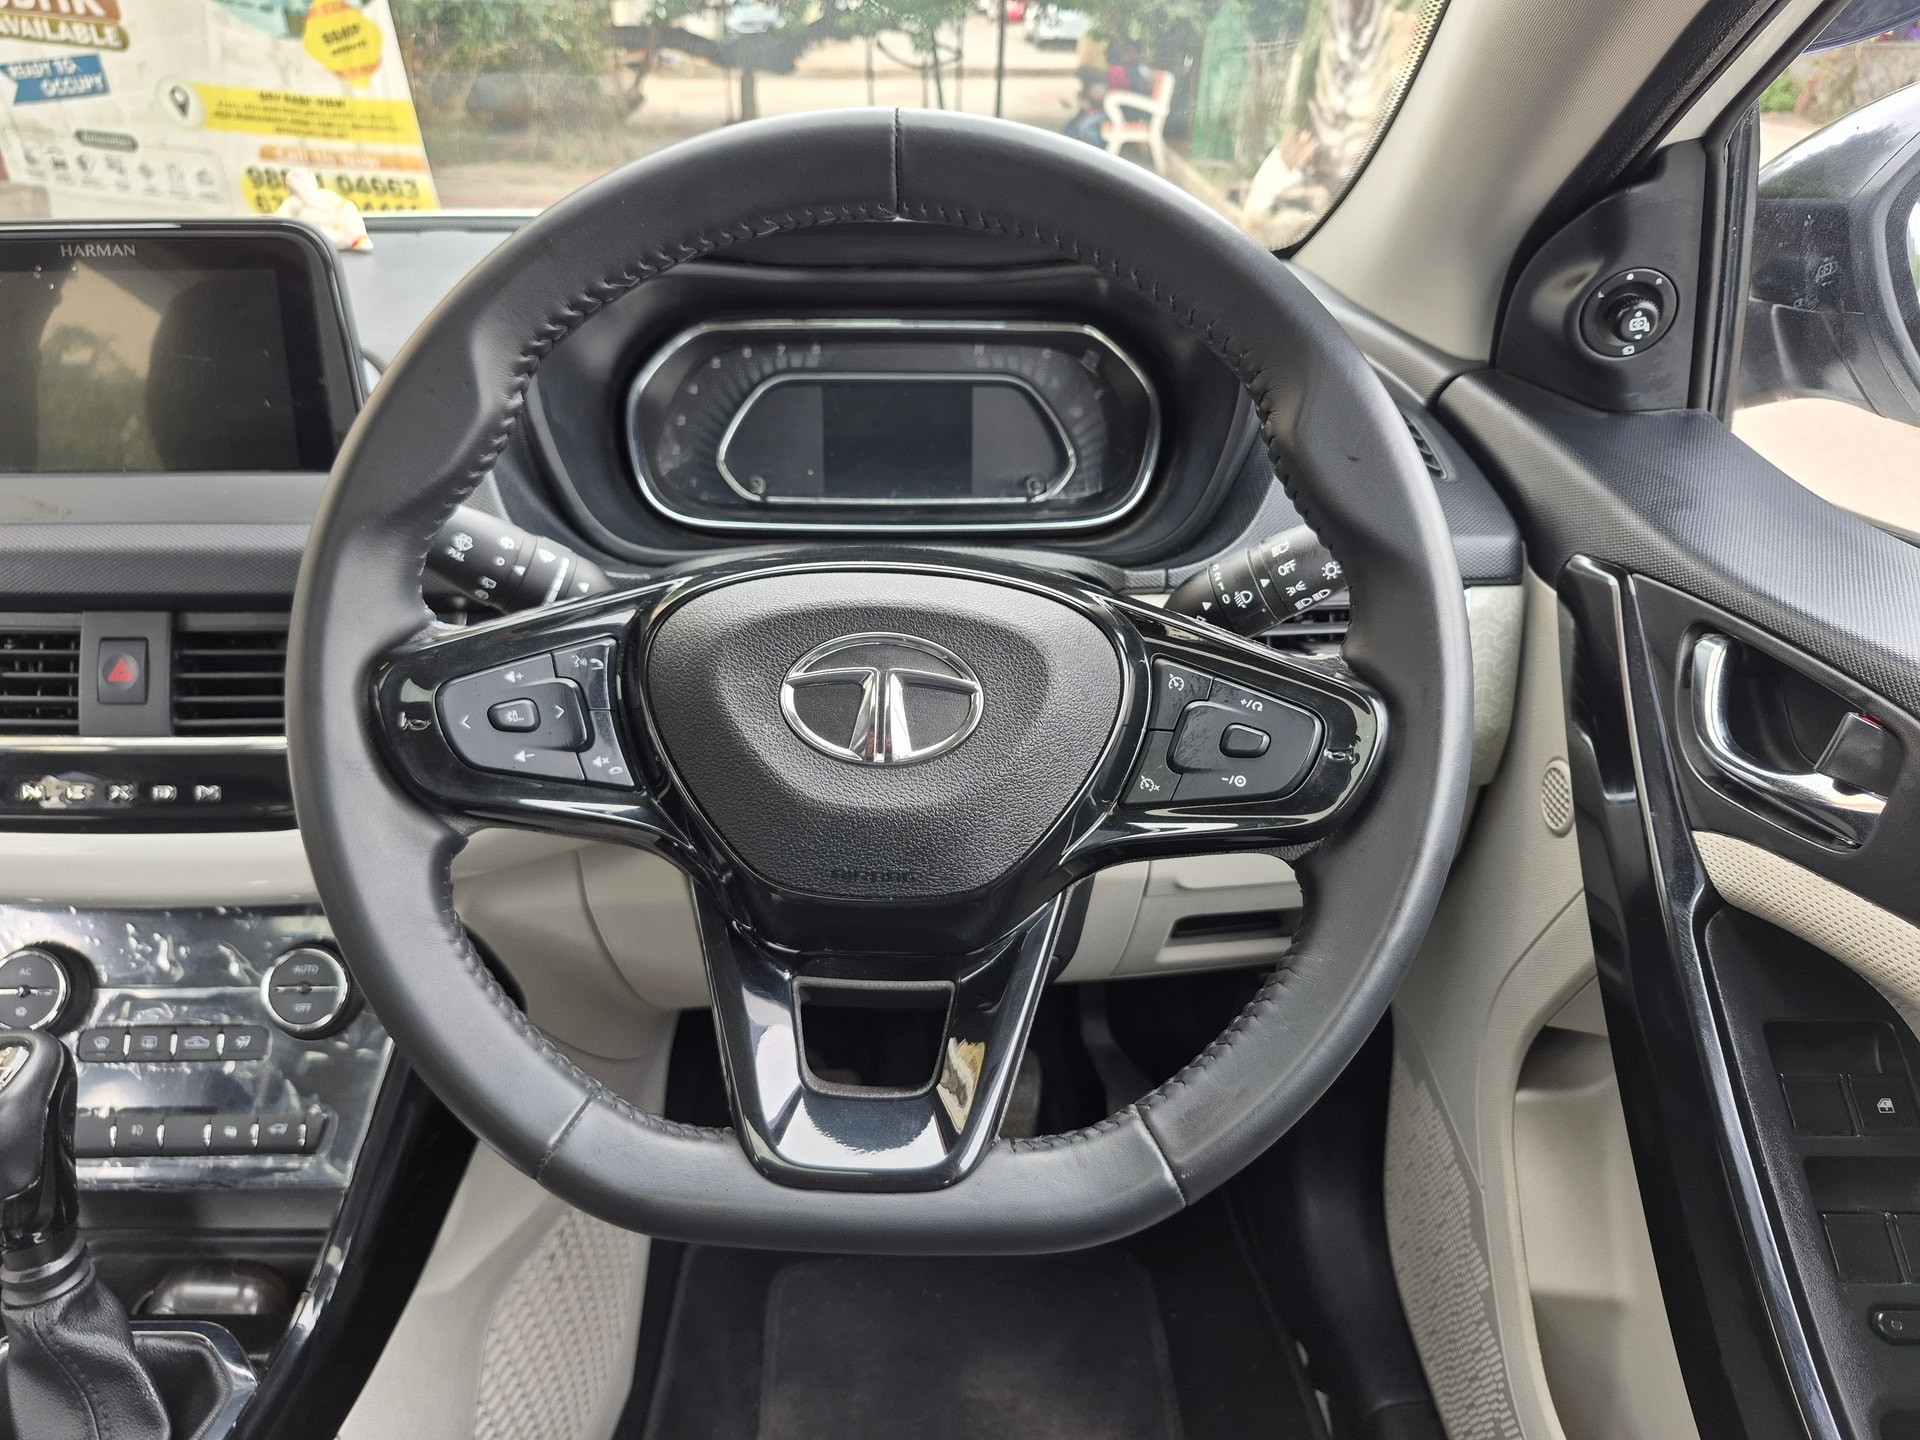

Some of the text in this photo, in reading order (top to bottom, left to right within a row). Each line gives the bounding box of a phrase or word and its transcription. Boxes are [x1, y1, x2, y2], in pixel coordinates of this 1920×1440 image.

[60, 243, 136, 257] HARMAN
[1278, 559, 1297, 576] OFF
[1213, 572, 1222, 582] 2
